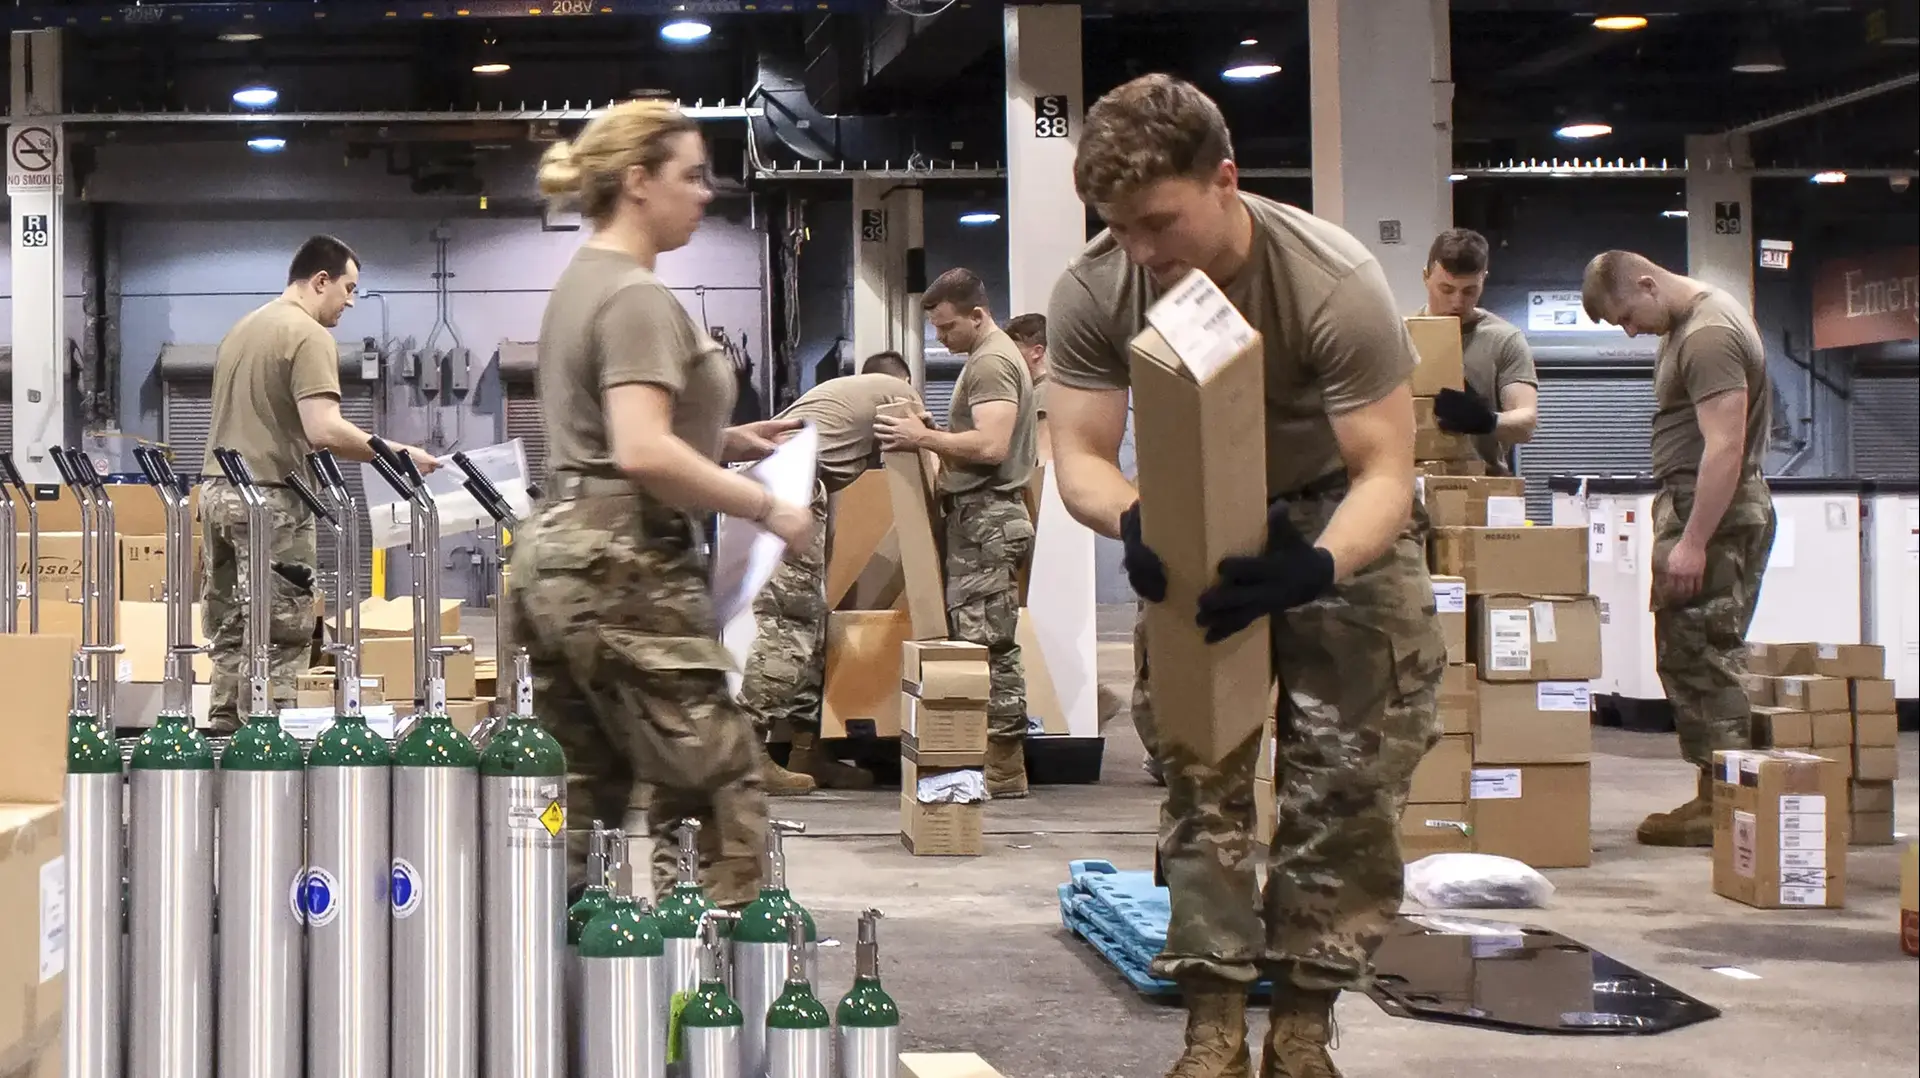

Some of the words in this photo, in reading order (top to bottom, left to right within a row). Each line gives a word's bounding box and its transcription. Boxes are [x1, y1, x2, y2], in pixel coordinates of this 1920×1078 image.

[552, 0, 593, 14] 208V
[1043, 97, 1059, 116] S
[1036, 117, 1068, 137] 38
[8, 175, 20, 185] NO
[869, 210, 881, 225] S
[1721, 203, 1733, 217] T
[28, 216, 41, 230] R
[1716, 218, 1740, 233] 39
[23, 231, 47, 246] 39
